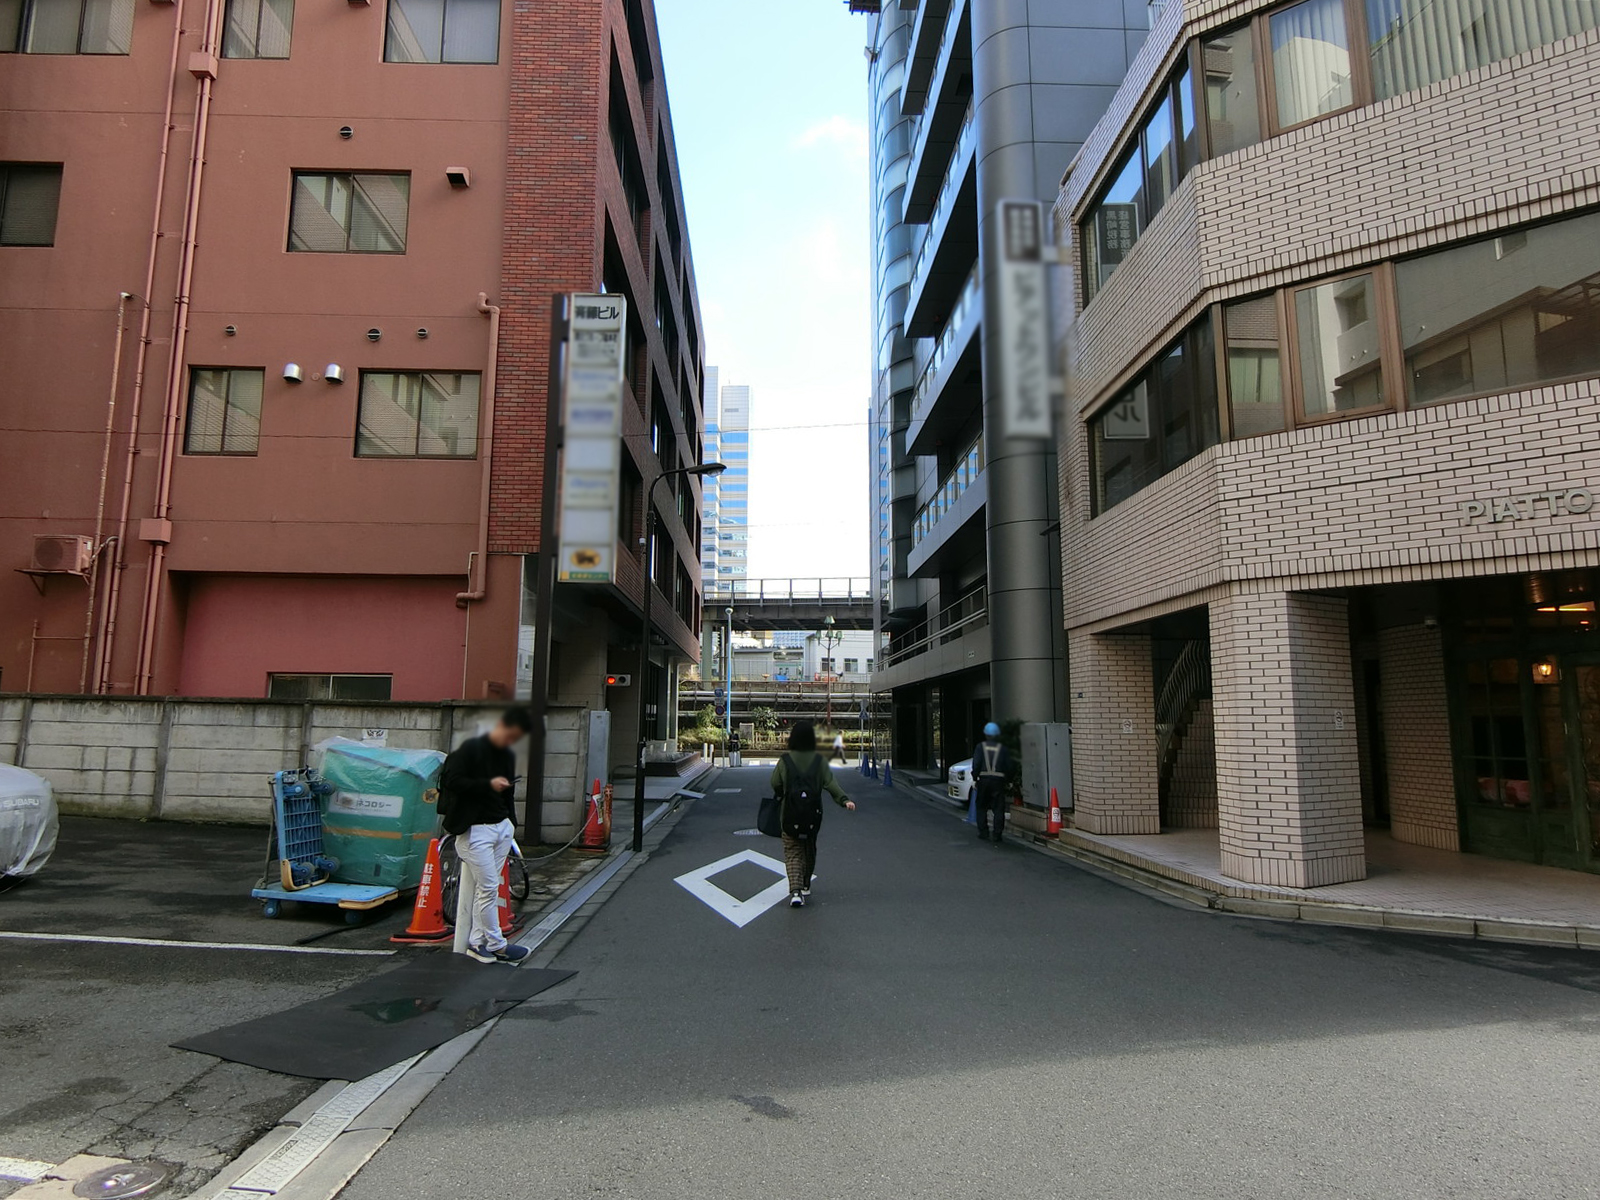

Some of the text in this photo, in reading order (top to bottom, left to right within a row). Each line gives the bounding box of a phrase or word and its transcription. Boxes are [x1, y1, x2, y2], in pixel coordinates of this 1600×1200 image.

[574, 306, 620, 320] ビル
[1461, 488, 1594, 526] PIATTO
[3, 798, 40, 808] SUBARU
[417, 863, 435, 908] 駐車禁止
